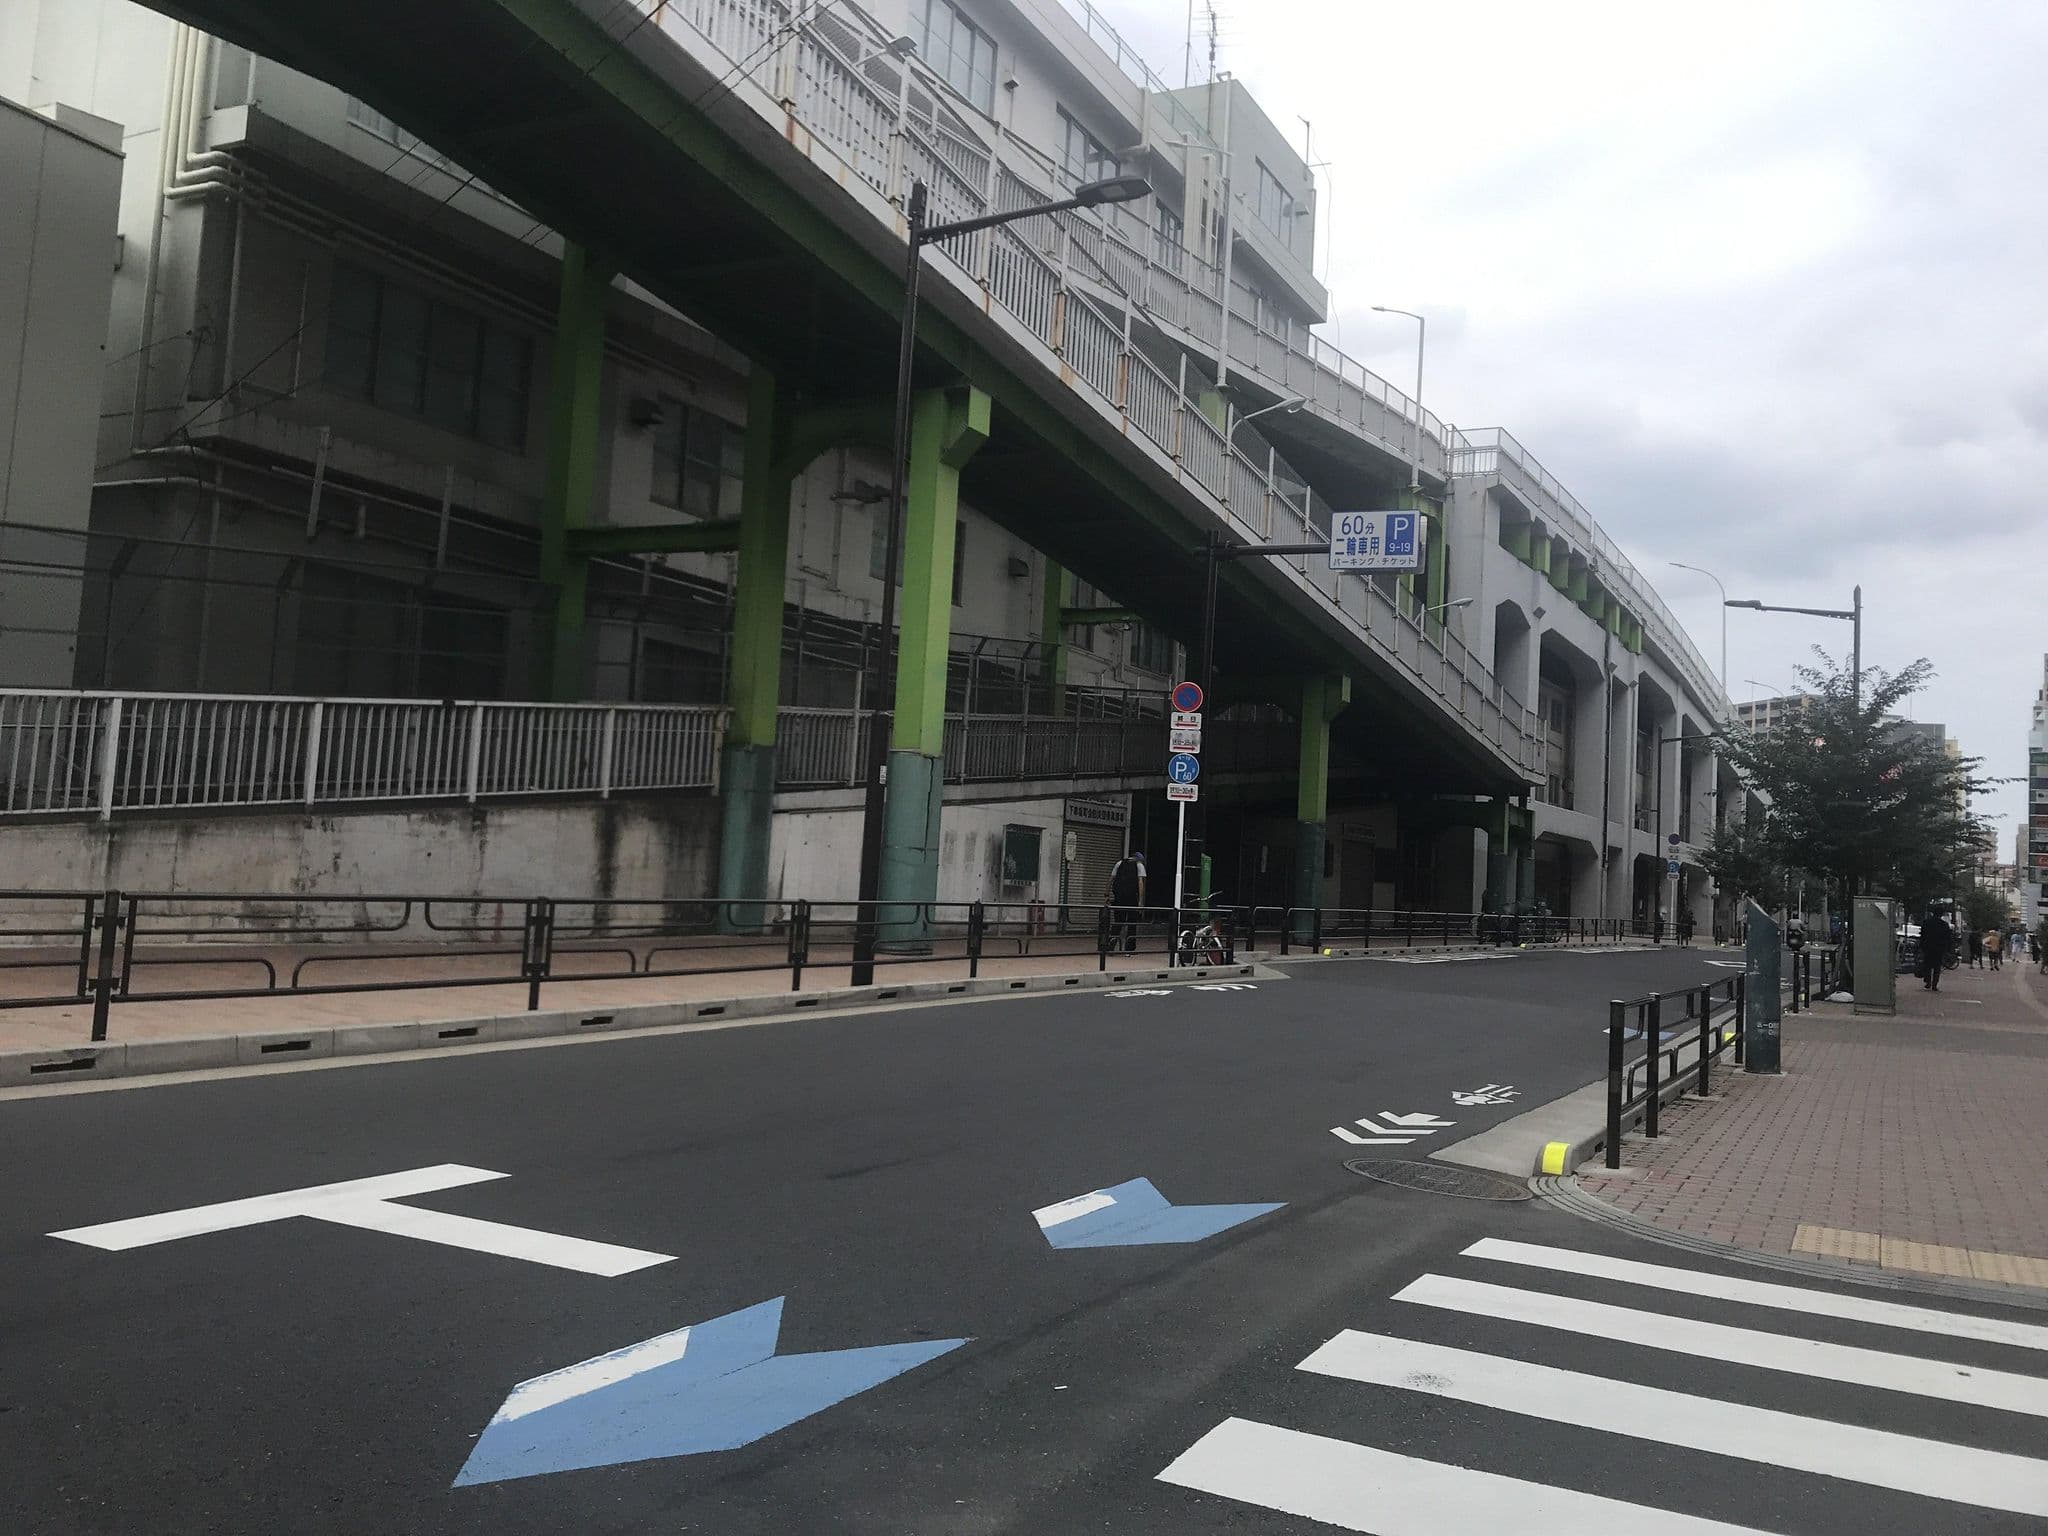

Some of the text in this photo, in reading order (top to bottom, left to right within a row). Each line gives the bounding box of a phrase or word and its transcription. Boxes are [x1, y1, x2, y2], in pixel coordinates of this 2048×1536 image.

[1341, 515, 1375, 535] 60分
[1393, 517, 1409, 540] P
[1334, 536, 1380, 556] 二輪車用
[1389, 542, 1411, 553] 9-19
[1176, 761, 1187, 780] P
